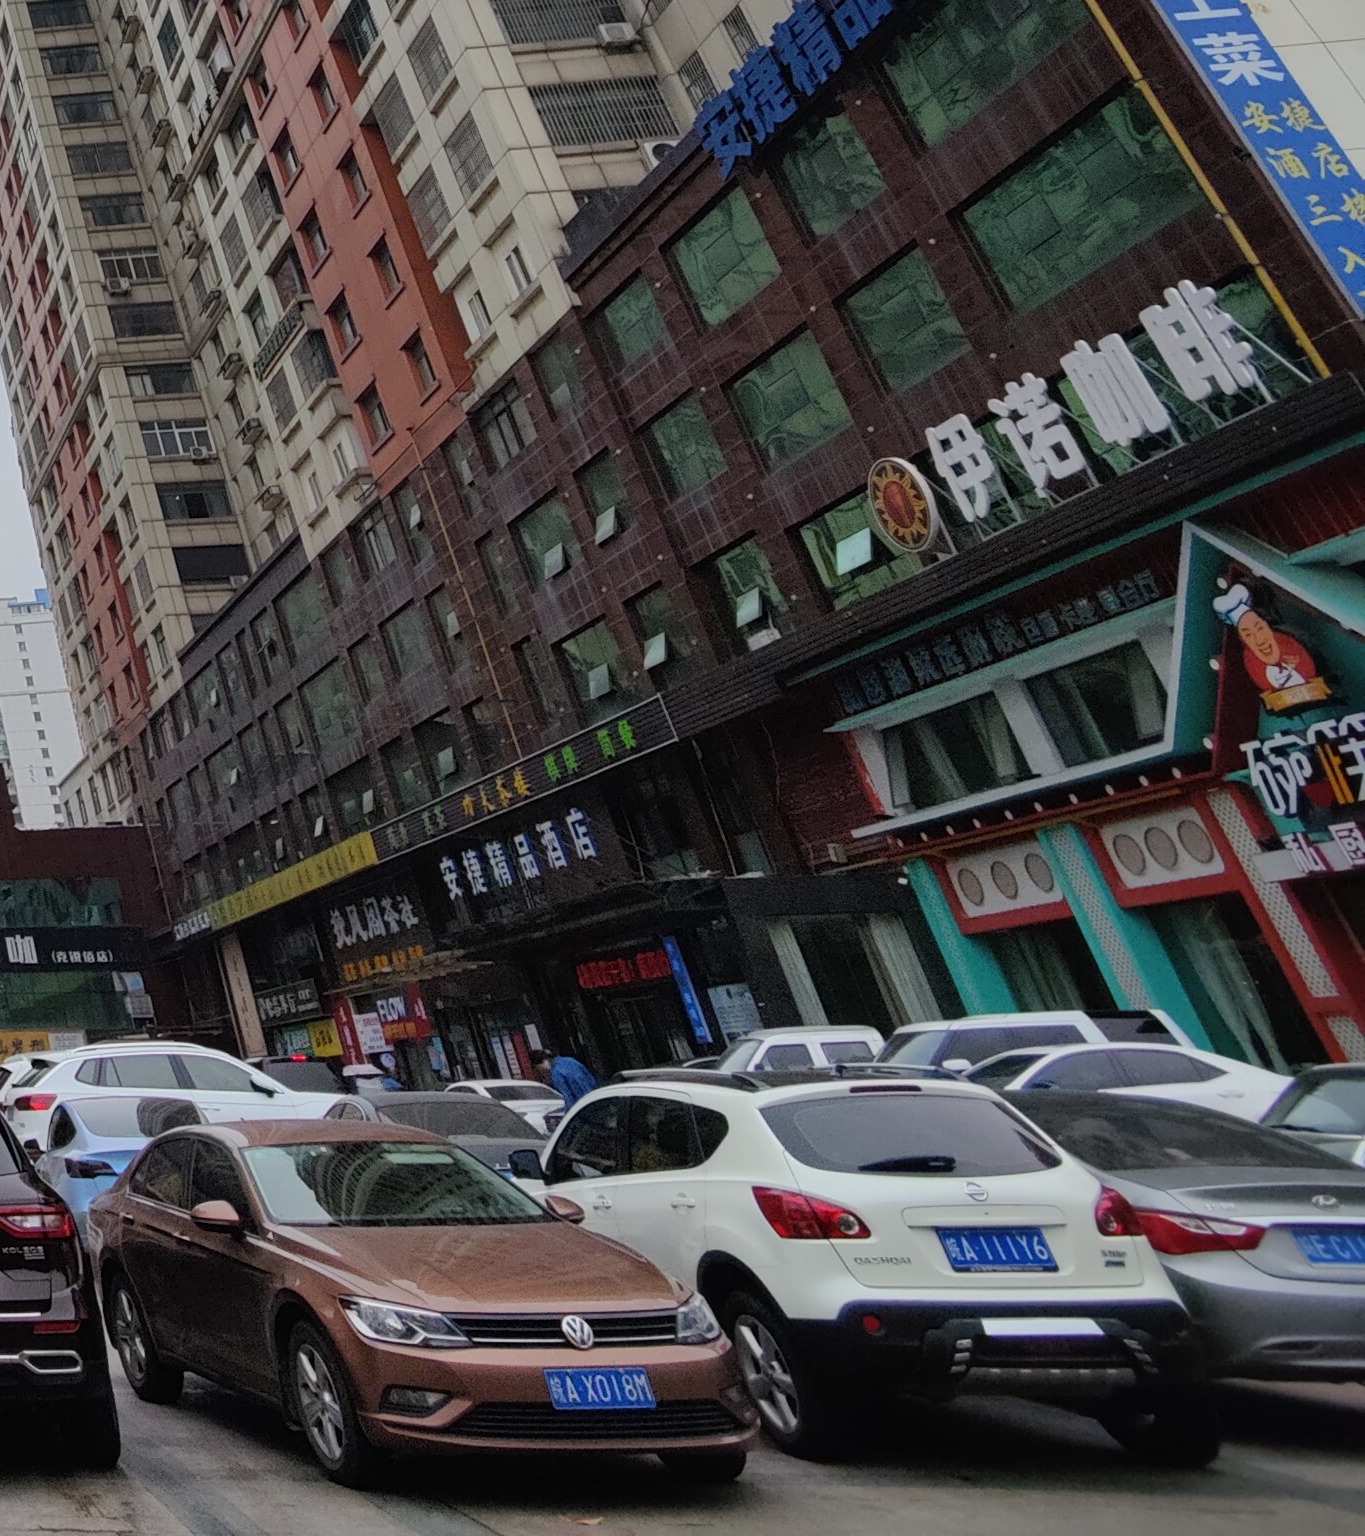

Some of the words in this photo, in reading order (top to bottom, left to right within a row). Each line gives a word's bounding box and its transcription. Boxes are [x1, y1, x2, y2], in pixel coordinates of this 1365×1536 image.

[1242, 98, 1326, 134] 安捷
[1266, 143, 1349, 179] 酒店
[439, 807, 598, 901] 安捷精品酒店
